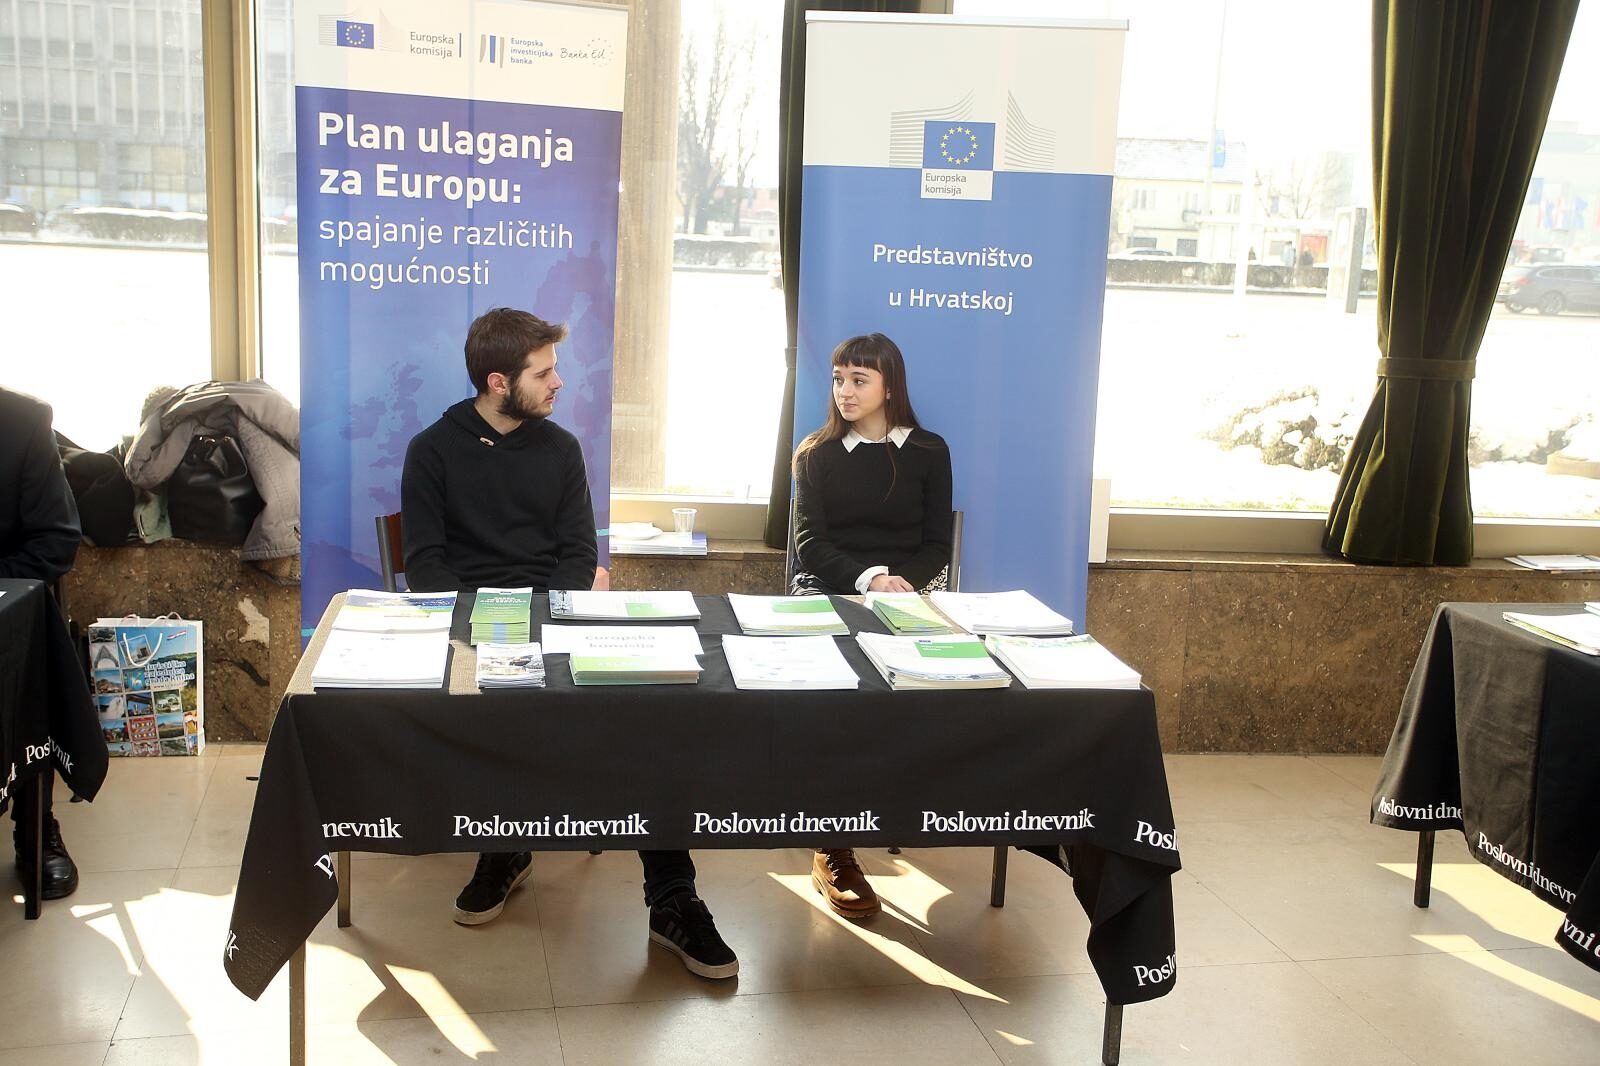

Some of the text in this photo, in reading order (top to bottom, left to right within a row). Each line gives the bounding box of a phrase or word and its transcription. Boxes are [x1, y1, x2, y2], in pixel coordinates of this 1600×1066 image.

[410, 31, 455, 45] Europska
[510, 37, 544, 47] Europska
[410, 44, 453, 59] komisija
[510, 47, 553, 57] investicijska
[510, 57, 533, 65] banka
[560, 47, 589, 59] Banka
[318, 111, 574, 169] Plan ulaganja
[319, 163, 522, 209] za Europu:
[925, 172, 968, 184] Europska
[925, 184, 962, 197] komisija
[319, 215, 574, 251] spajanje različitih
[873, 243, 1034, 268] Predstavništvo
[319, 256, 490, 290] mogućnosti
[888, 288, 1014, 316] u Hrvatskoj
[321, 816, 404, 839] nevnik
[452, 813, 650, 837] Poslovni dnevnik
[692, 810, 881, 834] Poslovni dnevnik
[920, 808, 1096, 832] Poslovni dnevnik
[1133, 820, 1179, 851] Posl
[1477, 831, 1534, 879] Poslovni
